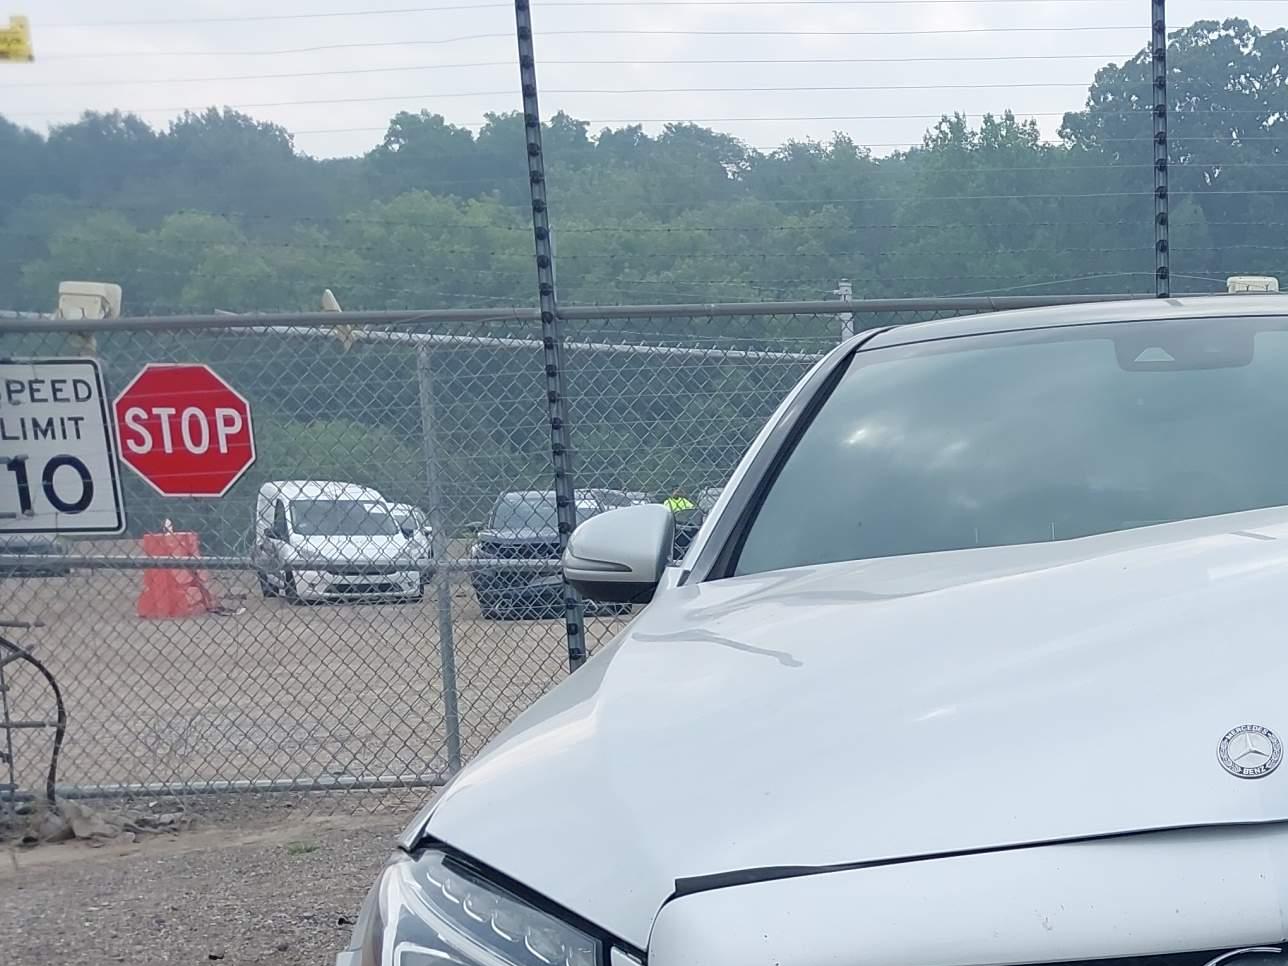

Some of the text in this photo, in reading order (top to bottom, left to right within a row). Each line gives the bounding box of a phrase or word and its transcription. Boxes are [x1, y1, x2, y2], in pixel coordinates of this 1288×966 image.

[0, 379, 92, 403] PEED
[0, 417, 84, 440] LIMIT
[124, 406, 243, 455] STOP
[7, 454, 94, 516] 10
[1243, 766, 1267, 775] BENZ
